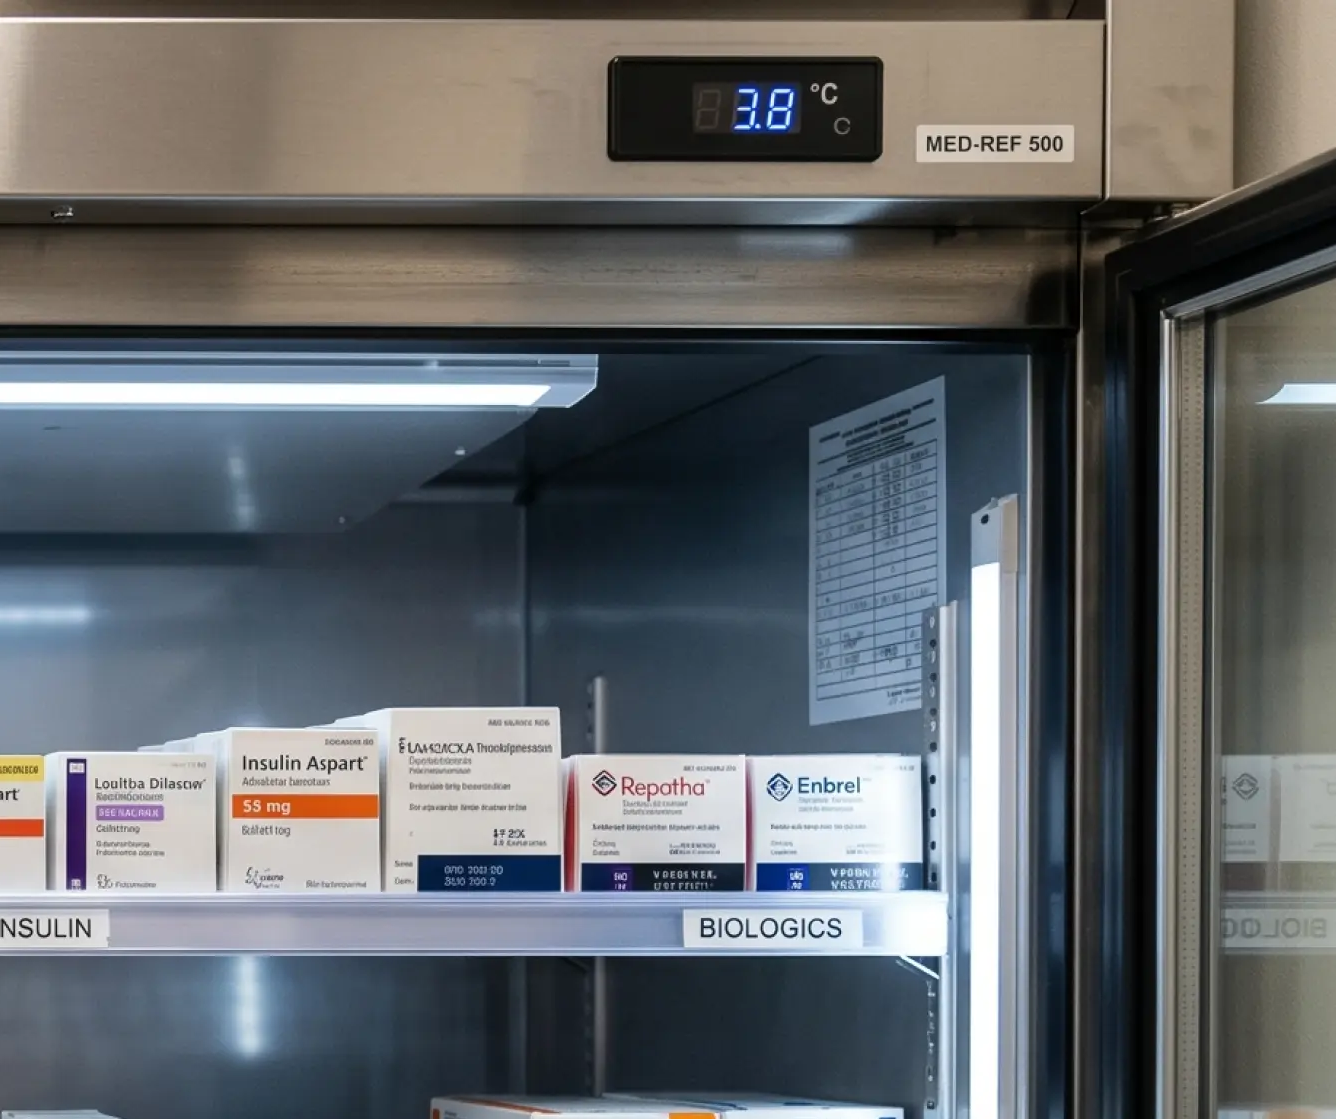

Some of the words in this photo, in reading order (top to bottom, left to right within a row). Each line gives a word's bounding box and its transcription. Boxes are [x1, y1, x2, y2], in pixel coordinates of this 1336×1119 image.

[926, 135, 1022, 153] MED-REF
[1028, 135, 1063, 153] 500
[242, 755, 301, 771] Insulin
[306, 756, 365, 775] Aspart
[621, 775, 706, 801] Repatha
[797, 776, 861, 794] Enbrel
[266, 801, 291, 815] mg
[700, 917, 842, 938] BIOLOGICS
